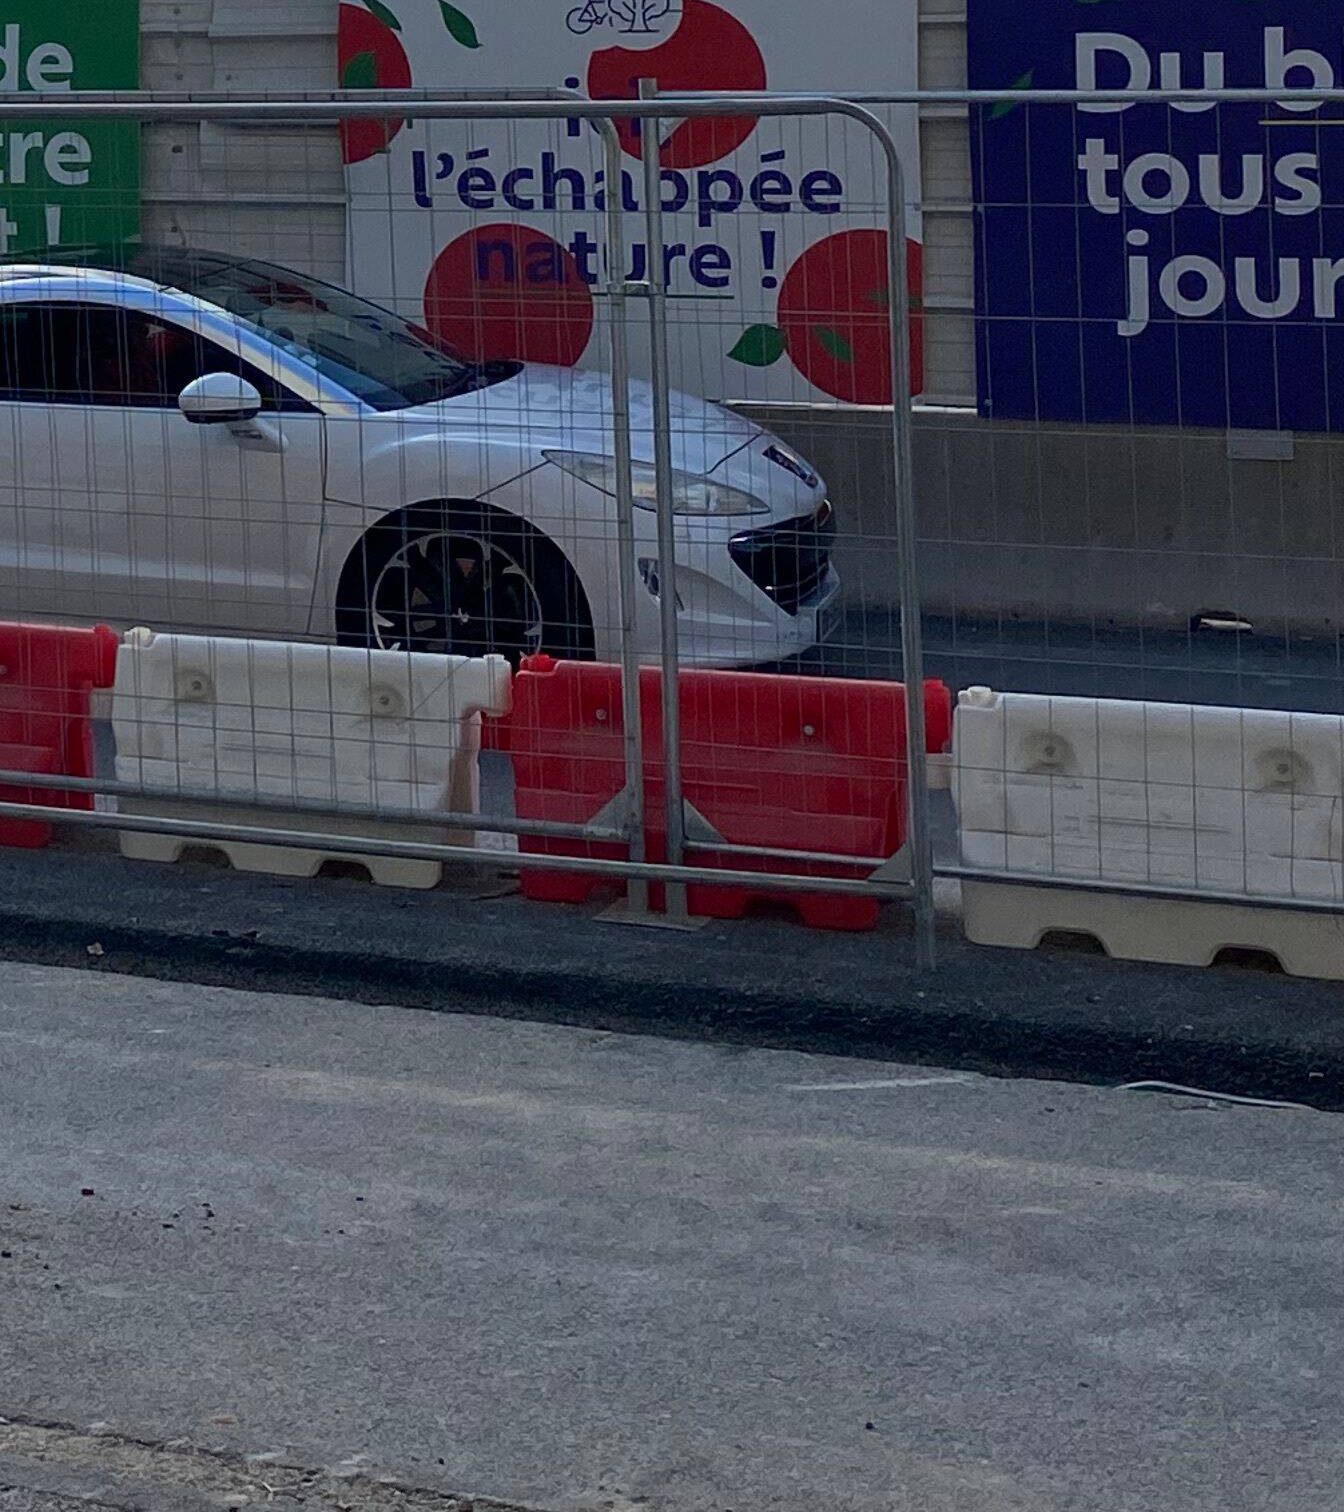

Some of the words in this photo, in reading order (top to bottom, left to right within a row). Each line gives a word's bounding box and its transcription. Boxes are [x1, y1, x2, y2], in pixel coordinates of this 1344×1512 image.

[1075, 32, 1225, 113] Du
[1078, 138, 1321, 216] tous
[476, 232, 732, 288] nature
[760, 231, 779, 289] !
